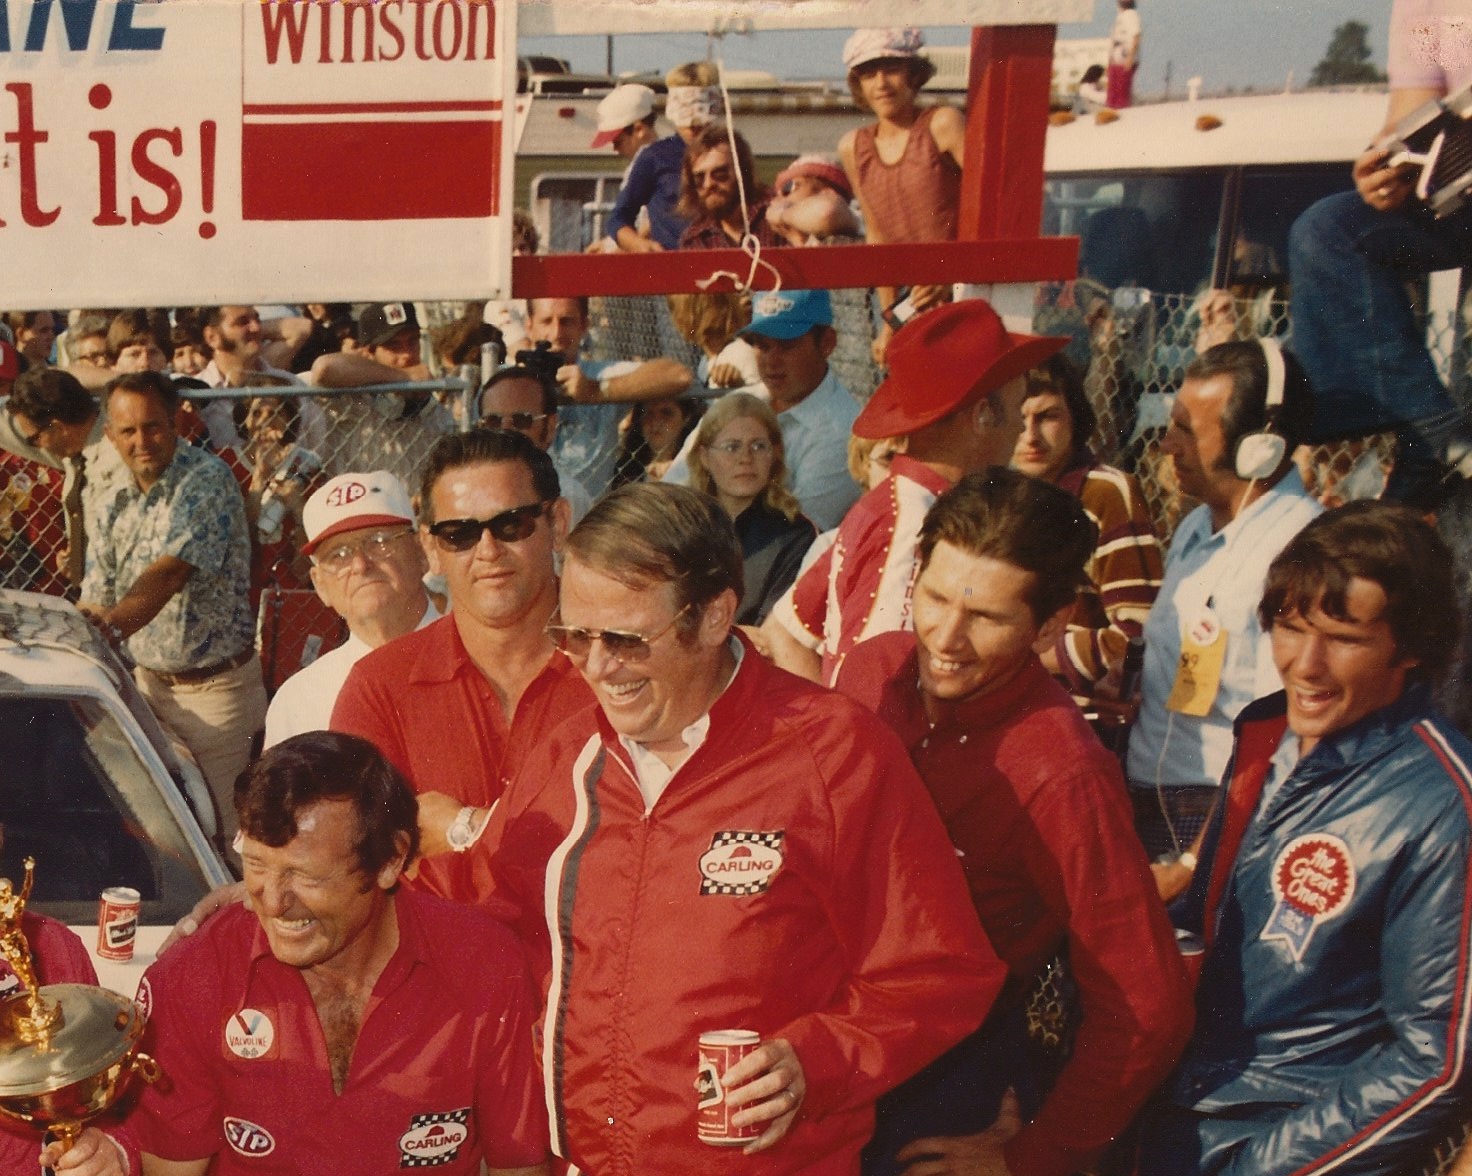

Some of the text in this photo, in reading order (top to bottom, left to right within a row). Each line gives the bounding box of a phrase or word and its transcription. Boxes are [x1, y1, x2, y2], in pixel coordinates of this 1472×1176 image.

[261, 0, 496, 64] Winston
[88, 83, 217, 240] is!
[706, 860, 774, 874] CARLING
[1290, 858, 1339, 896] Great
[1287, 878, 1328, 912] Ones
[230, 1036, 268, 1048] VALVOLINE
[228, 1121, 270, 1151] STP
[404, 1132, 462, 1151] CARLING
